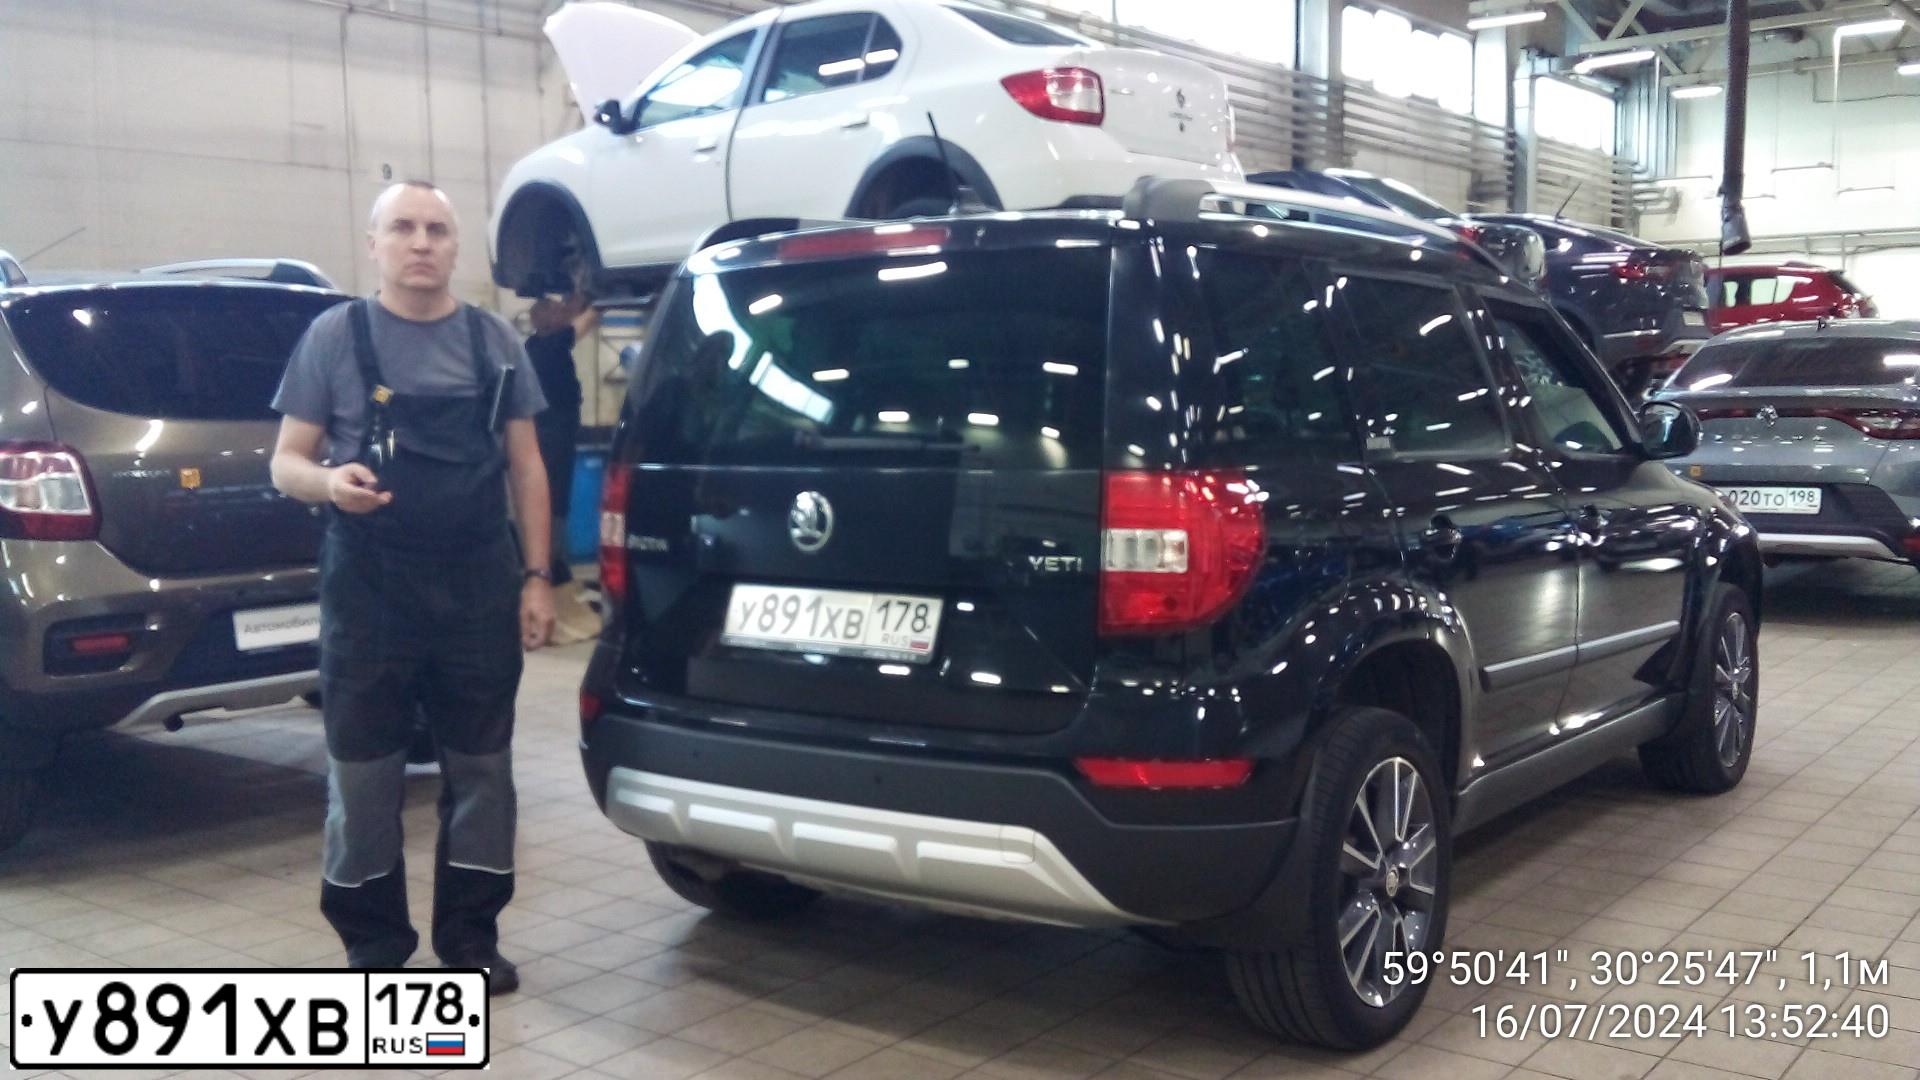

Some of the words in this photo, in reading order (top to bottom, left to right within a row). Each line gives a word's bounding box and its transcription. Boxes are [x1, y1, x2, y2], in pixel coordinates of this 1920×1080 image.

[1789, 490, 1816, 503] 198
[1028, 555, 1082, 572] YETI
[877, 599, 930, 633] 178
[880, 633, 909, 648] RUS
